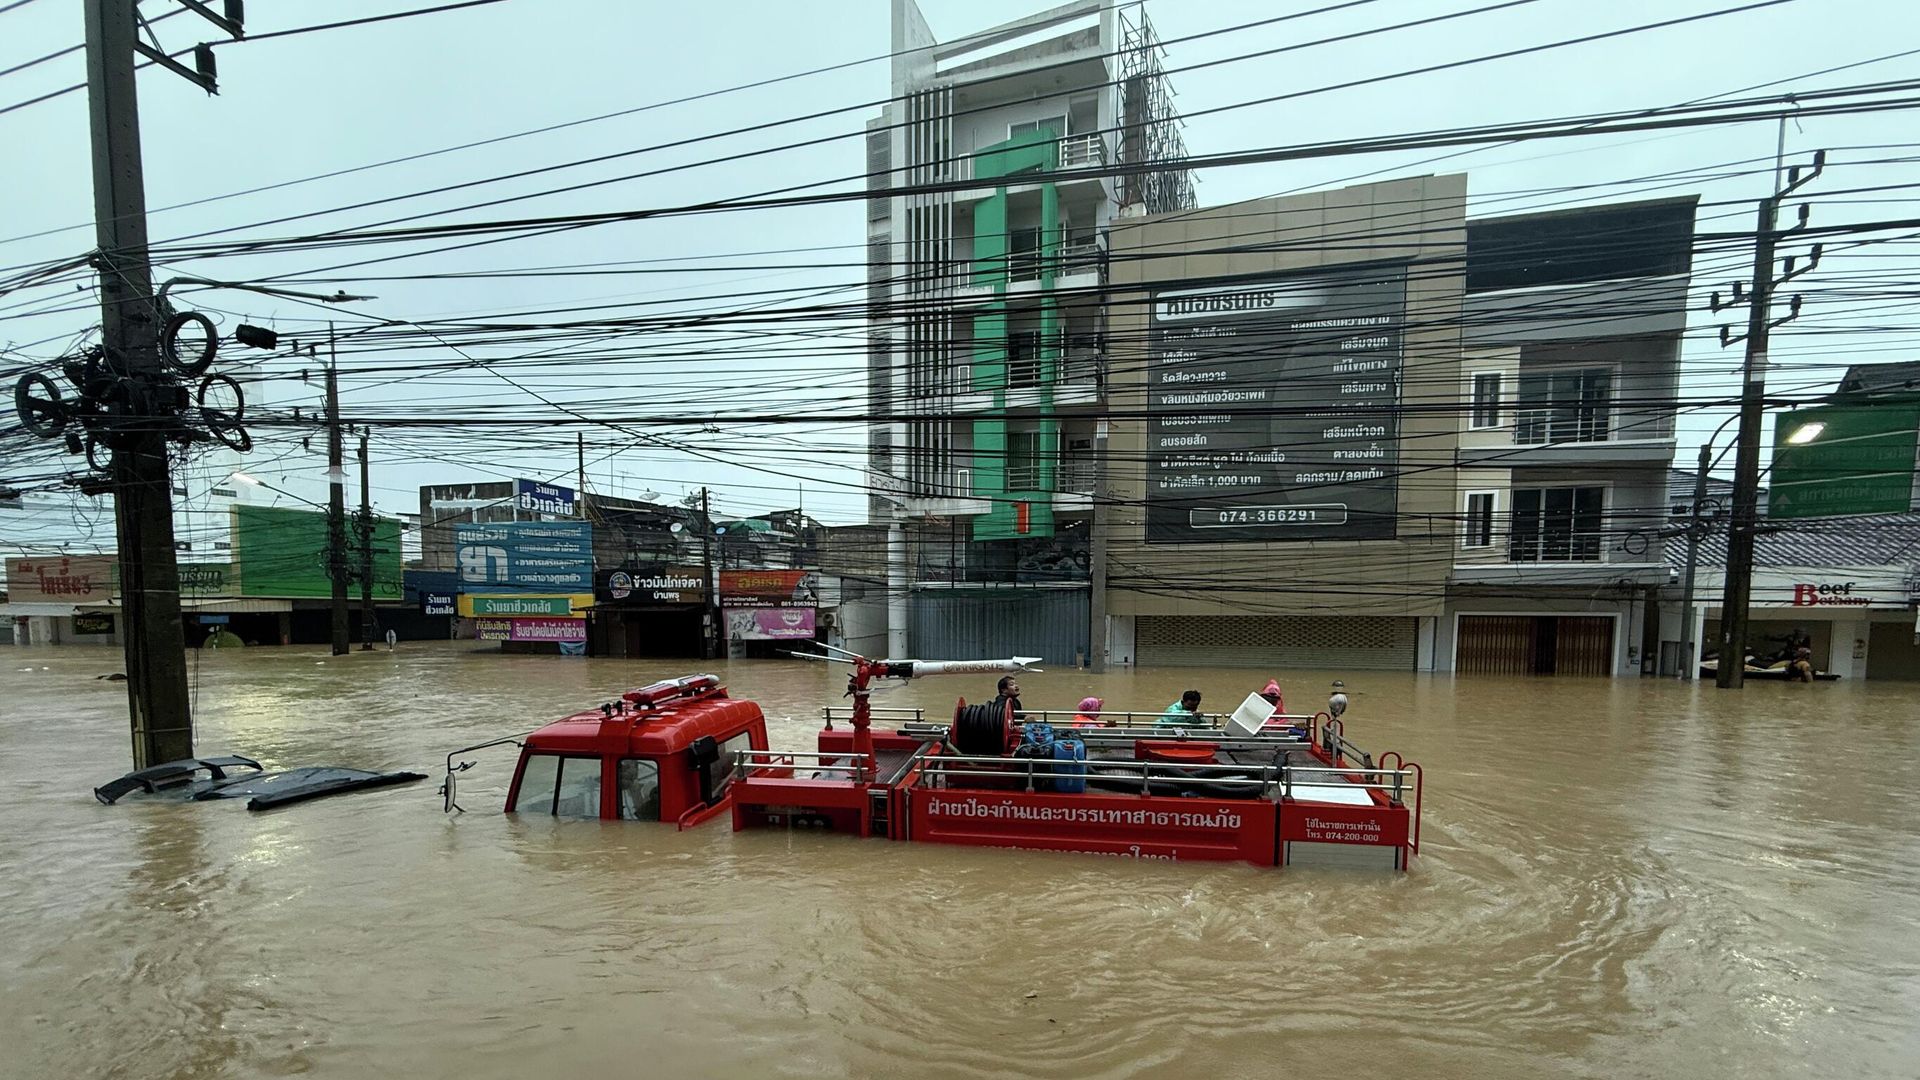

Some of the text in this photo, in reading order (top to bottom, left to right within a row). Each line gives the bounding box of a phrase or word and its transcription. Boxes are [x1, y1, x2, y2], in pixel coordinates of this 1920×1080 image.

[1323, 424, 1385, 439] เสริมหน้าอก
[1160, 433, 1207, 447] ลบรอยสัก
[1208, 475, 1238, 488] 1,000
[1219, 510, 1316, 522] 074-366291
[459, 546, 509, 582] ยา
[653, 591, 680, 602] บ้านพรุ
[928, 797, 1241, 829] ฝ่ายป้องกันและบรรเทาสาธารณภัย
[1305, 817, 1381, 832] ใช้ในราชการเท่านั้น
[1325, 831, 1379, 842] 074-200-000
